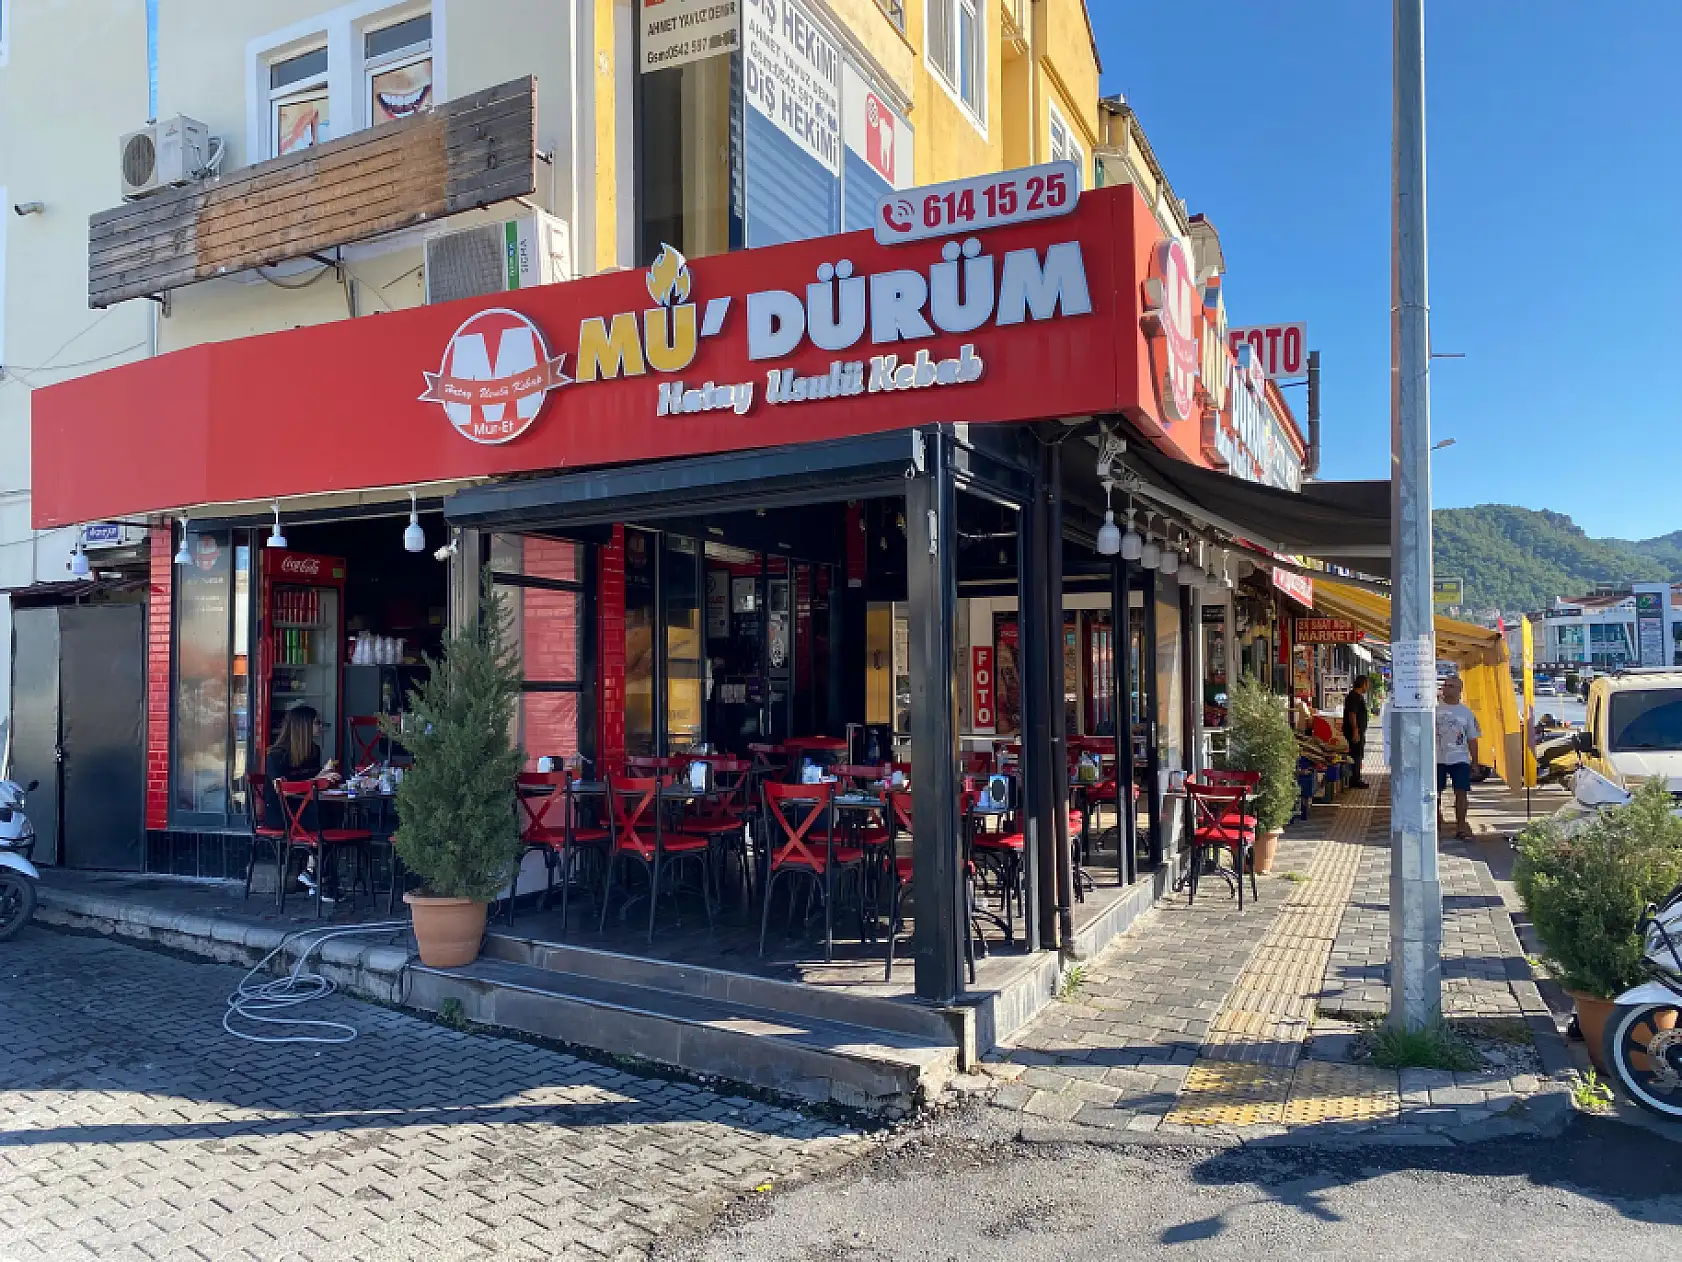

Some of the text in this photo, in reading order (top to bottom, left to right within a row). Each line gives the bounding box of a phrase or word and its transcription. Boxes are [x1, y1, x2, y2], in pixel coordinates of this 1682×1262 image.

[923, 173, 1066, 228] 614 15 25
[747, 237, 1092, 361] DÜRÜM
[656, 344, 984, 417] Hatay Usulü Kebab
[1298, 631, 1353, 640] MARKET
[976, 651, 990, 724] FOTO
